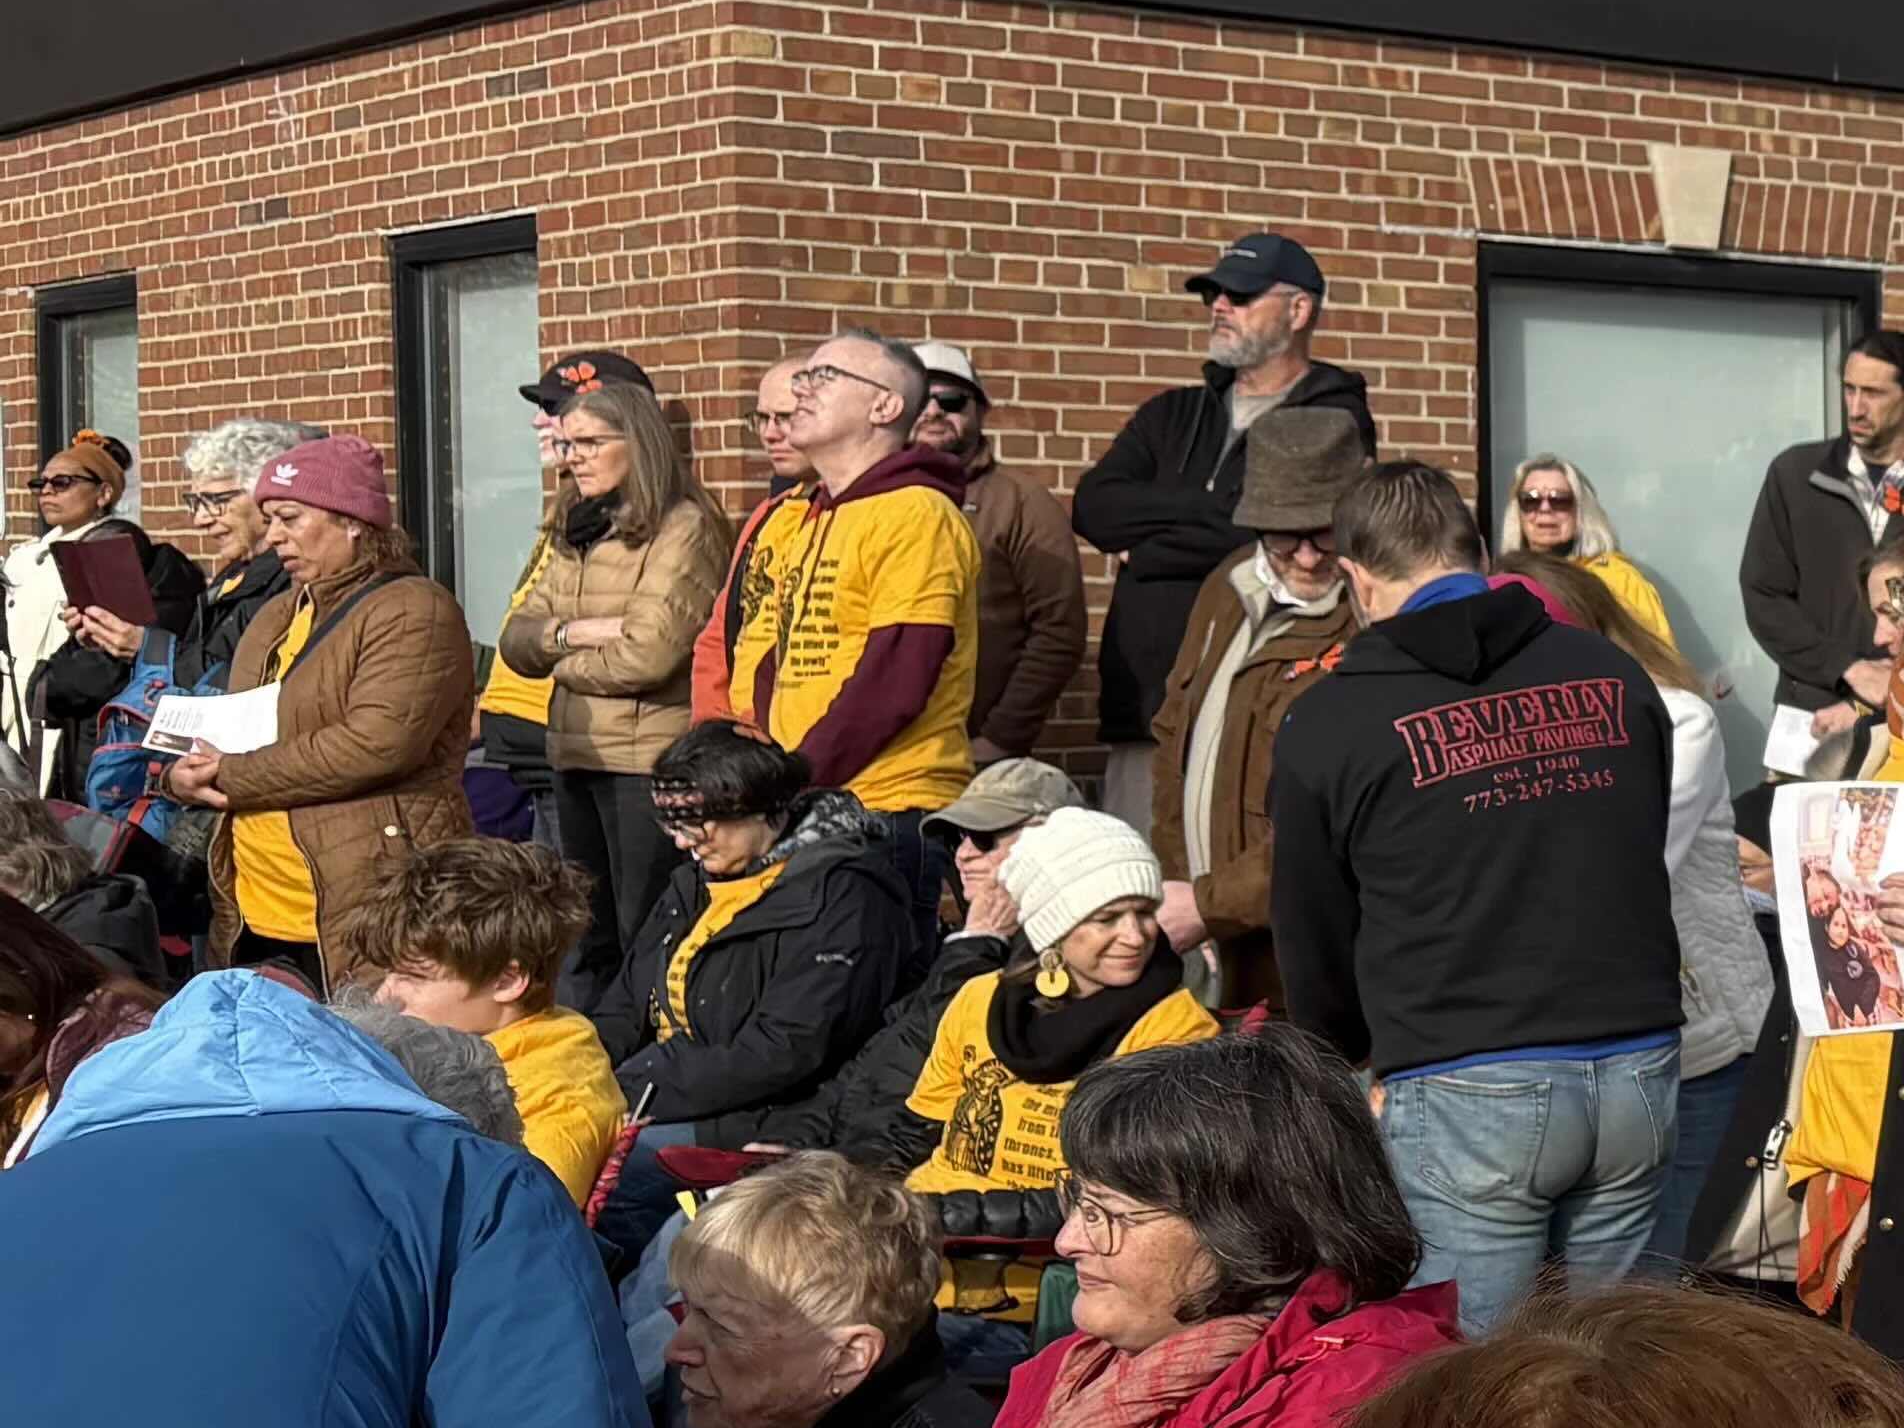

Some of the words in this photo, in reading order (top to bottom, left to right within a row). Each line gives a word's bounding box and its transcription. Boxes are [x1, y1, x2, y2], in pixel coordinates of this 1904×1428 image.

[1392, 677, 1630, 789] BEVERLY
[1449, 733, 1530, 772] ASPHALT
[1535, 753, 1580, 775] 1940
[1462, 768, 1616, 813] 773-247-5345
